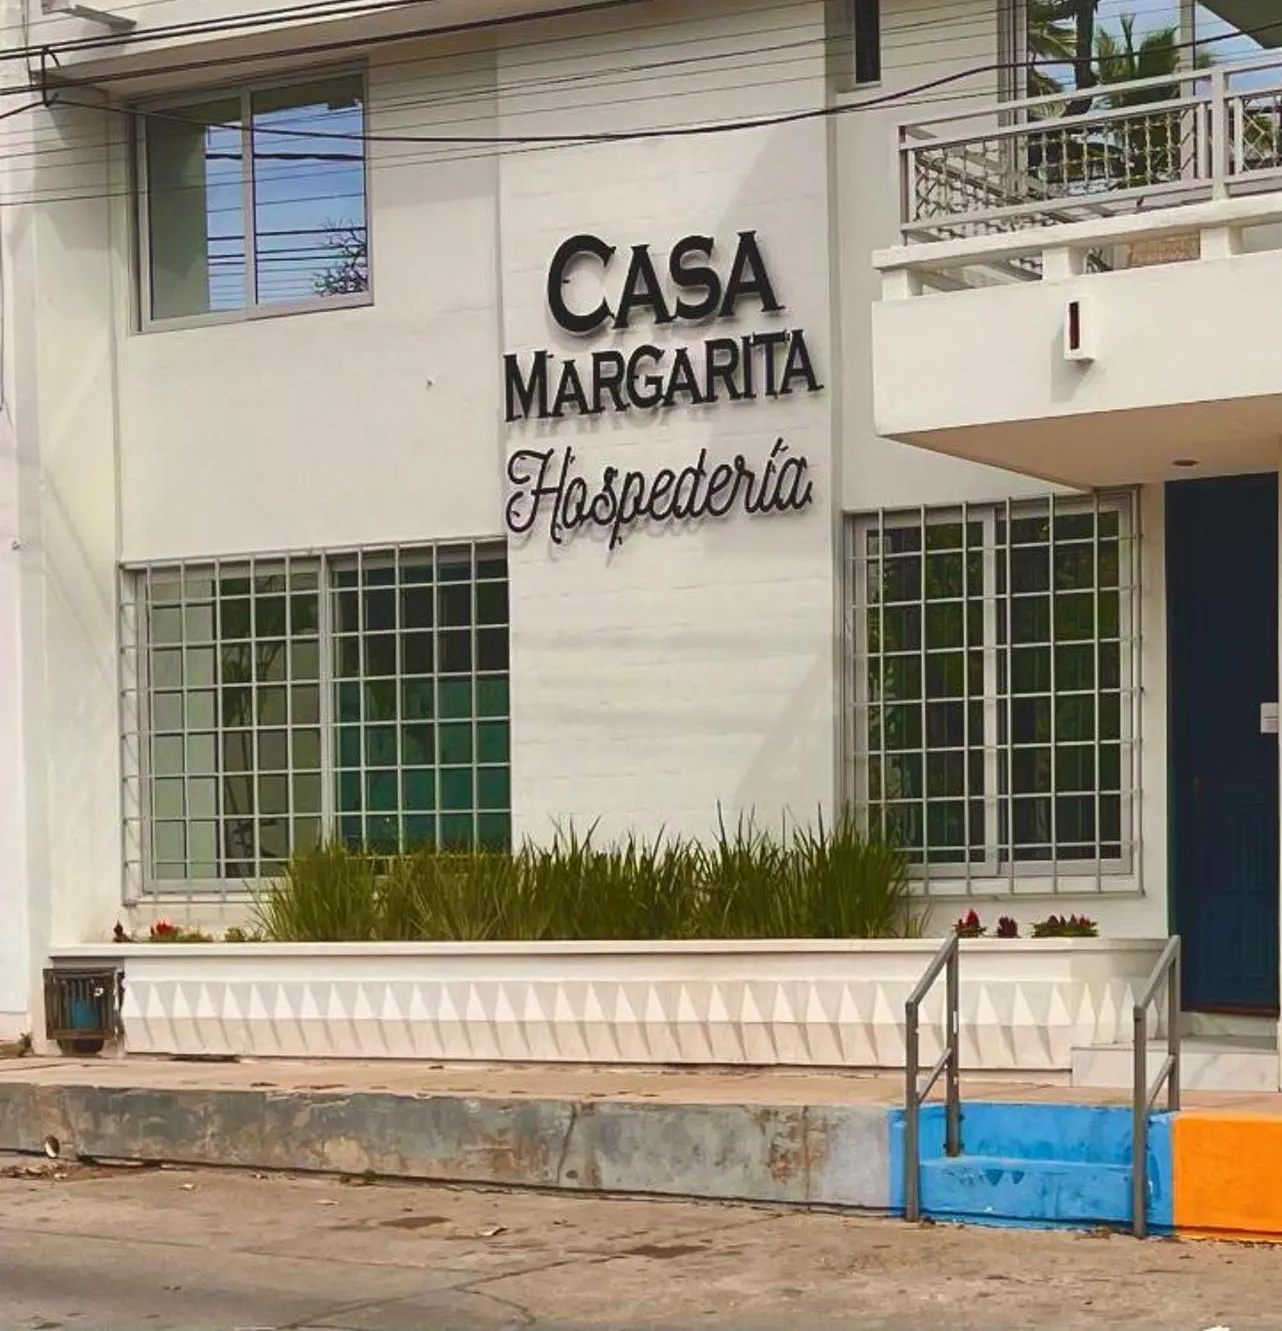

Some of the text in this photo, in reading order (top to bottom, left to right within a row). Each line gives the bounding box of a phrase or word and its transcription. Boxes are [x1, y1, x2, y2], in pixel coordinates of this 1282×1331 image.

[547, 230, 785, 333] CASA
[503, 329, 825, 422] MARGARITA
[505, 437, 813, 550] Hospedería
